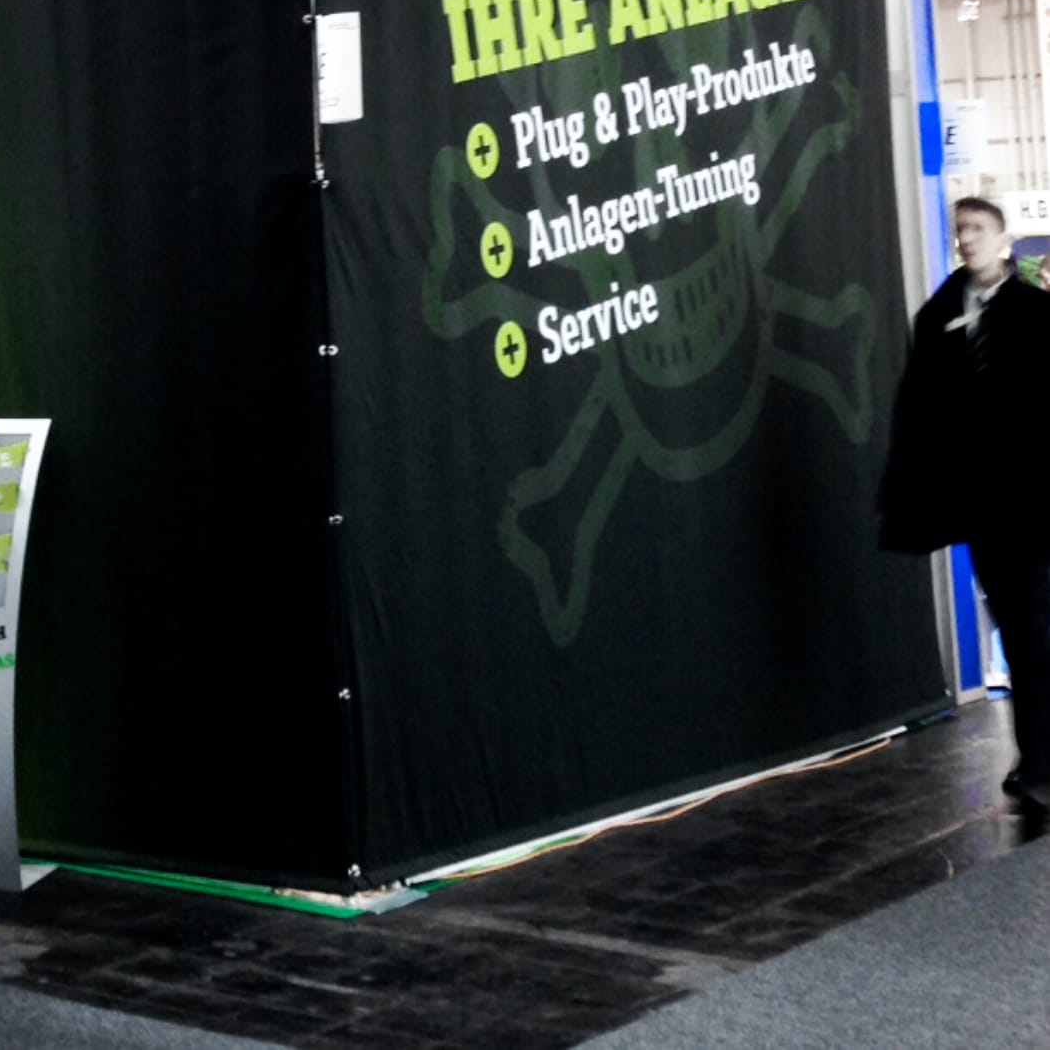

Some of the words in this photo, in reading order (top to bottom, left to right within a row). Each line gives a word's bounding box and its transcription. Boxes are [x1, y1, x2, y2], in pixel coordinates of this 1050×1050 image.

[510, 106, 590, 169] Plug
[592, 91, 620, 145] &
[621, 41, 817, 138] Play-Produkte
[527, 150, 761, 268] Anlagen-Tuning
[538, 282, 660, 364] Service
